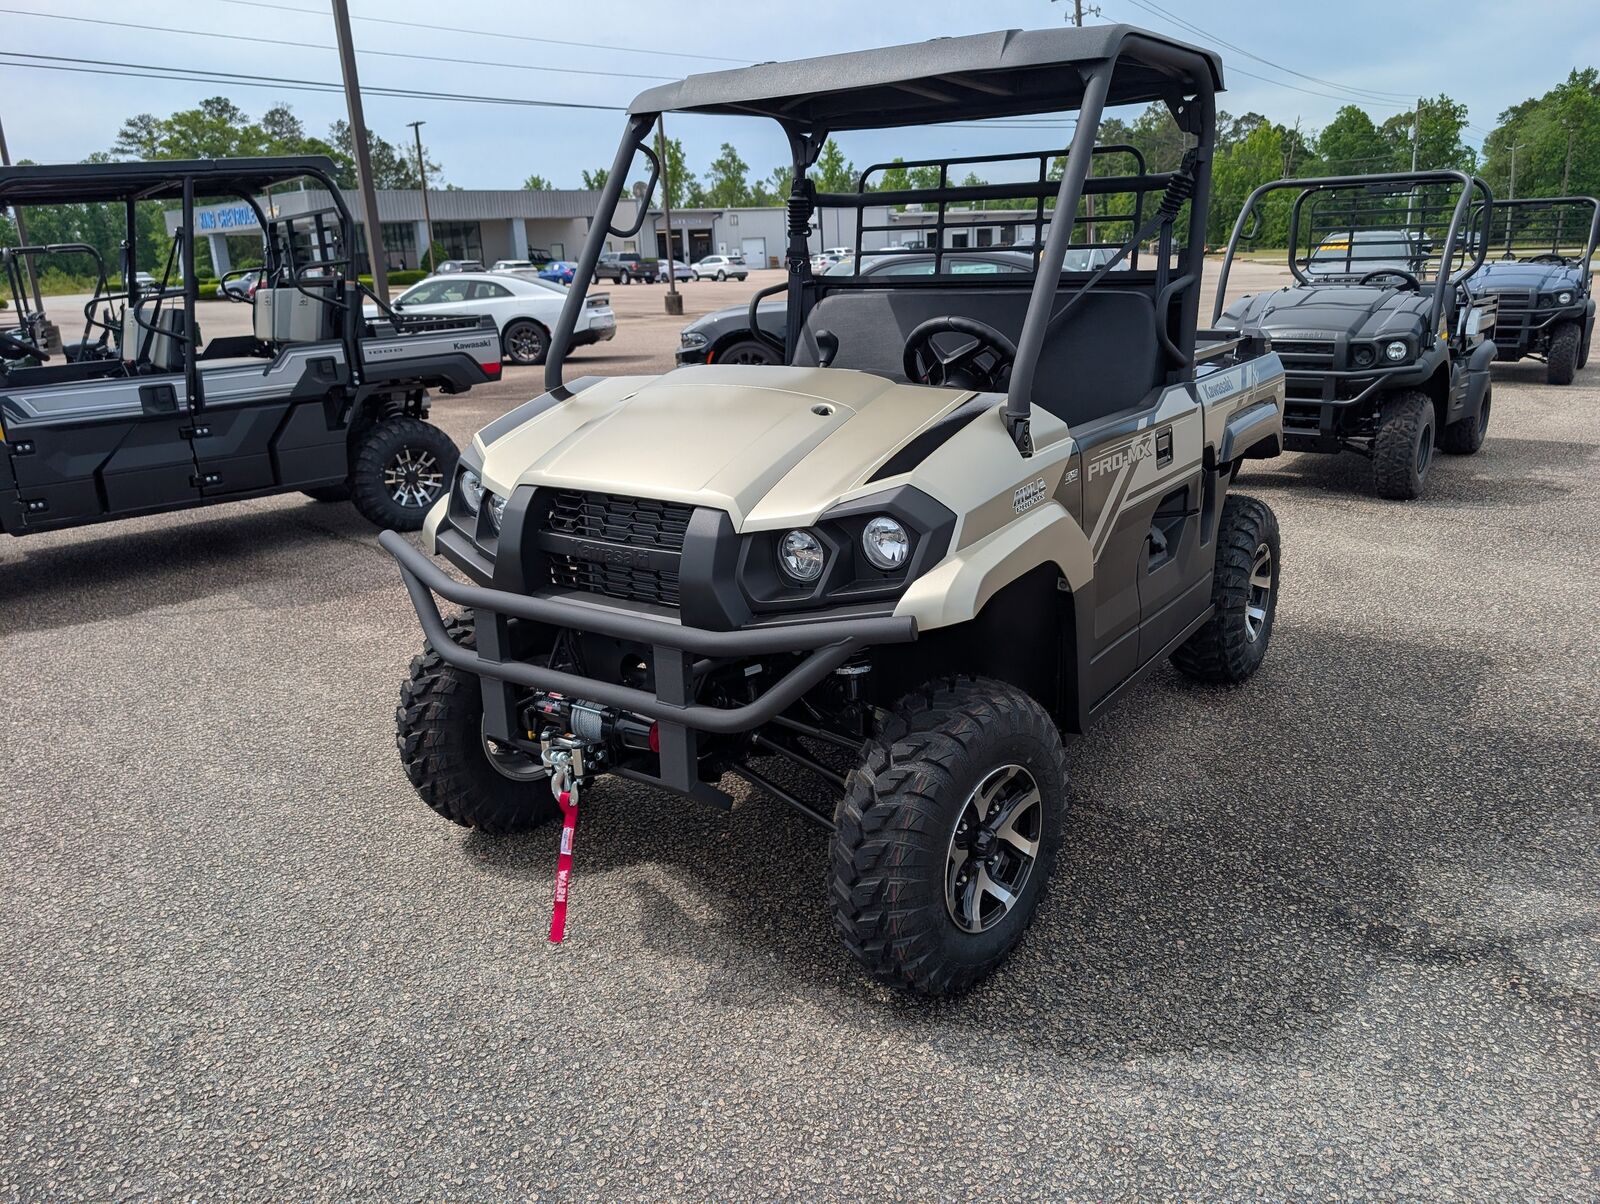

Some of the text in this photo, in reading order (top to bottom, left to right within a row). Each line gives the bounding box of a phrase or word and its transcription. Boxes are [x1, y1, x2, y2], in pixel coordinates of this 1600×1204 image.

[218, 205, 257, 228] CHEVROLE
[453, 340, 491, 350] Kawasaki
[1202, 375, 1234, 400] Kawasaki
[1087, 440, 1153, 482] PRO-MX
[1013, 477, 1047, 508] MULE
[556, 869, 569, 903] WARN
